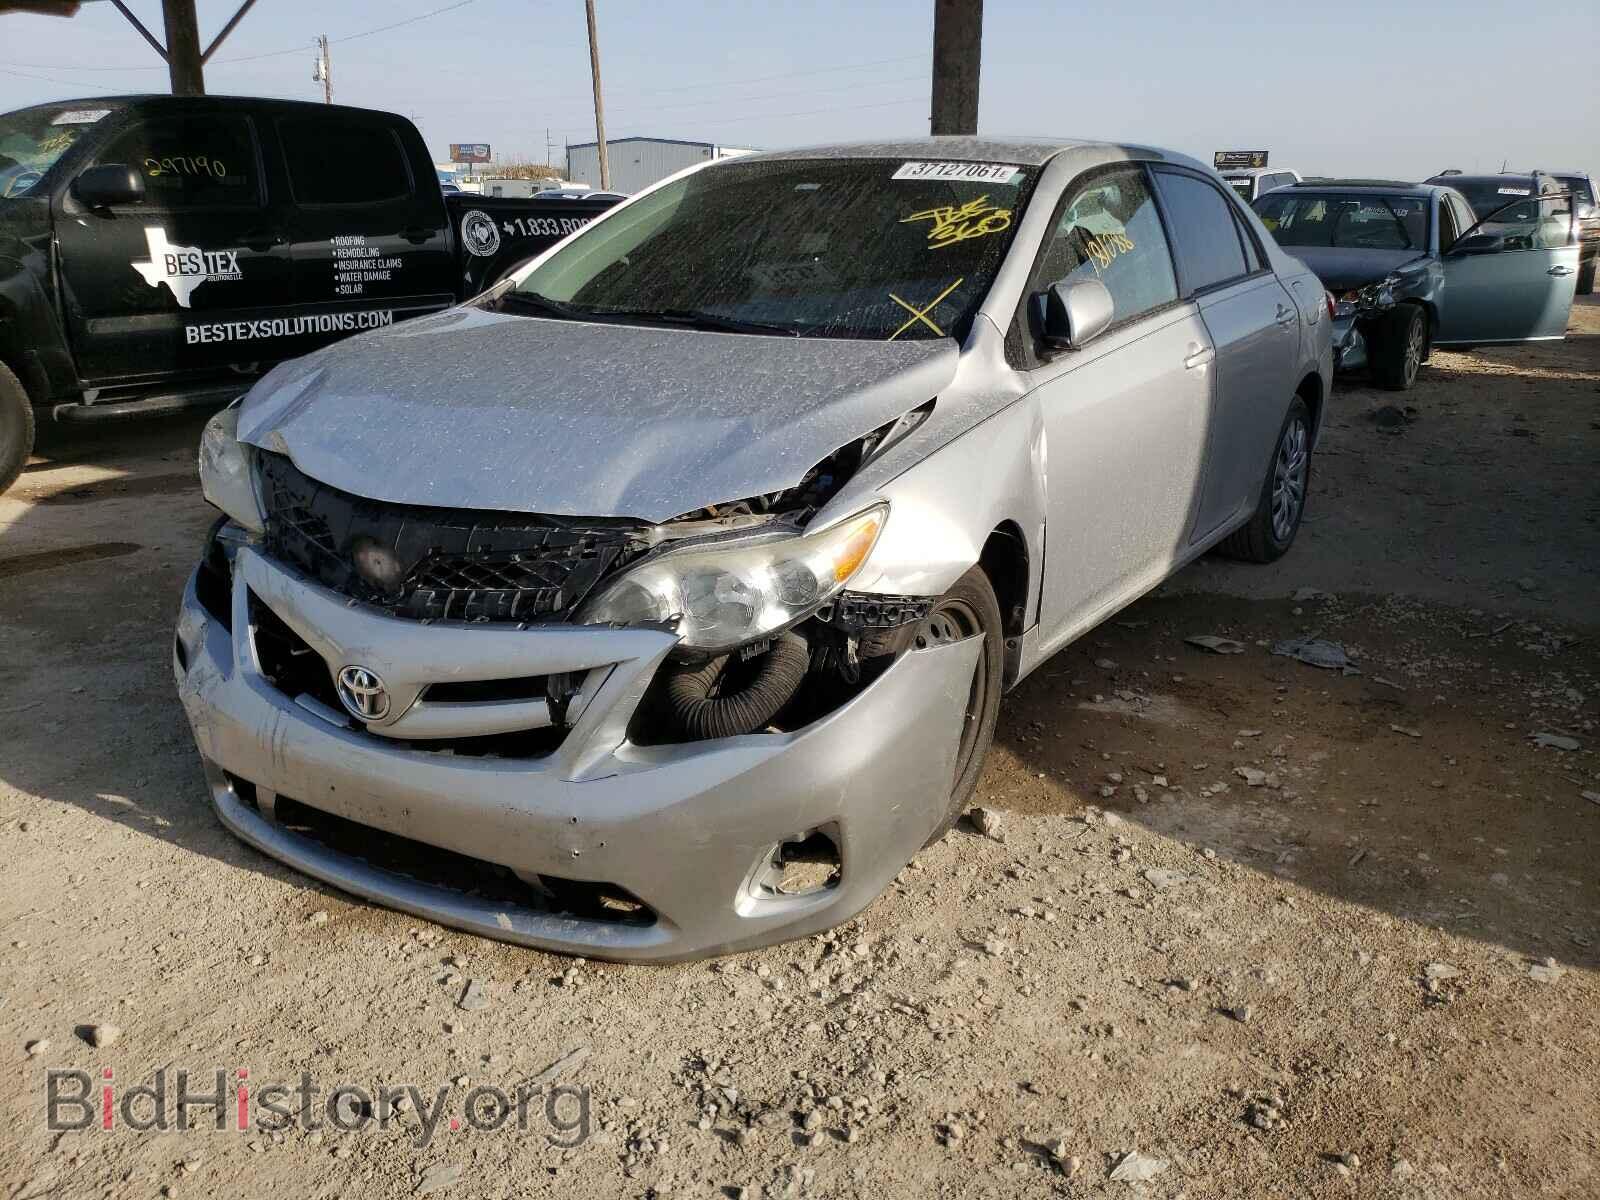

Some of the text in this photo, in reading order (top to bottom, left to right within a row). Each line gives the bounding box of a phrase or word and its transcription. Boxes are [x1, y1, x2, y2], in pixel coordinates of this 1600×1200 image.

[915, 163, 1001, 178] 37127061
[335, 236, 365, 246] ROOFING
[337, 248, 380, 258] REMODELING
[339, 258, 402, 270] INSURANCE CLAIMS
[340, 271, 392, 282] WATER DAMAGE
[340, 284, 363, 295] SOLAR
[185, 310, 393, 344] BESTEXSOLUTIONS.COM
